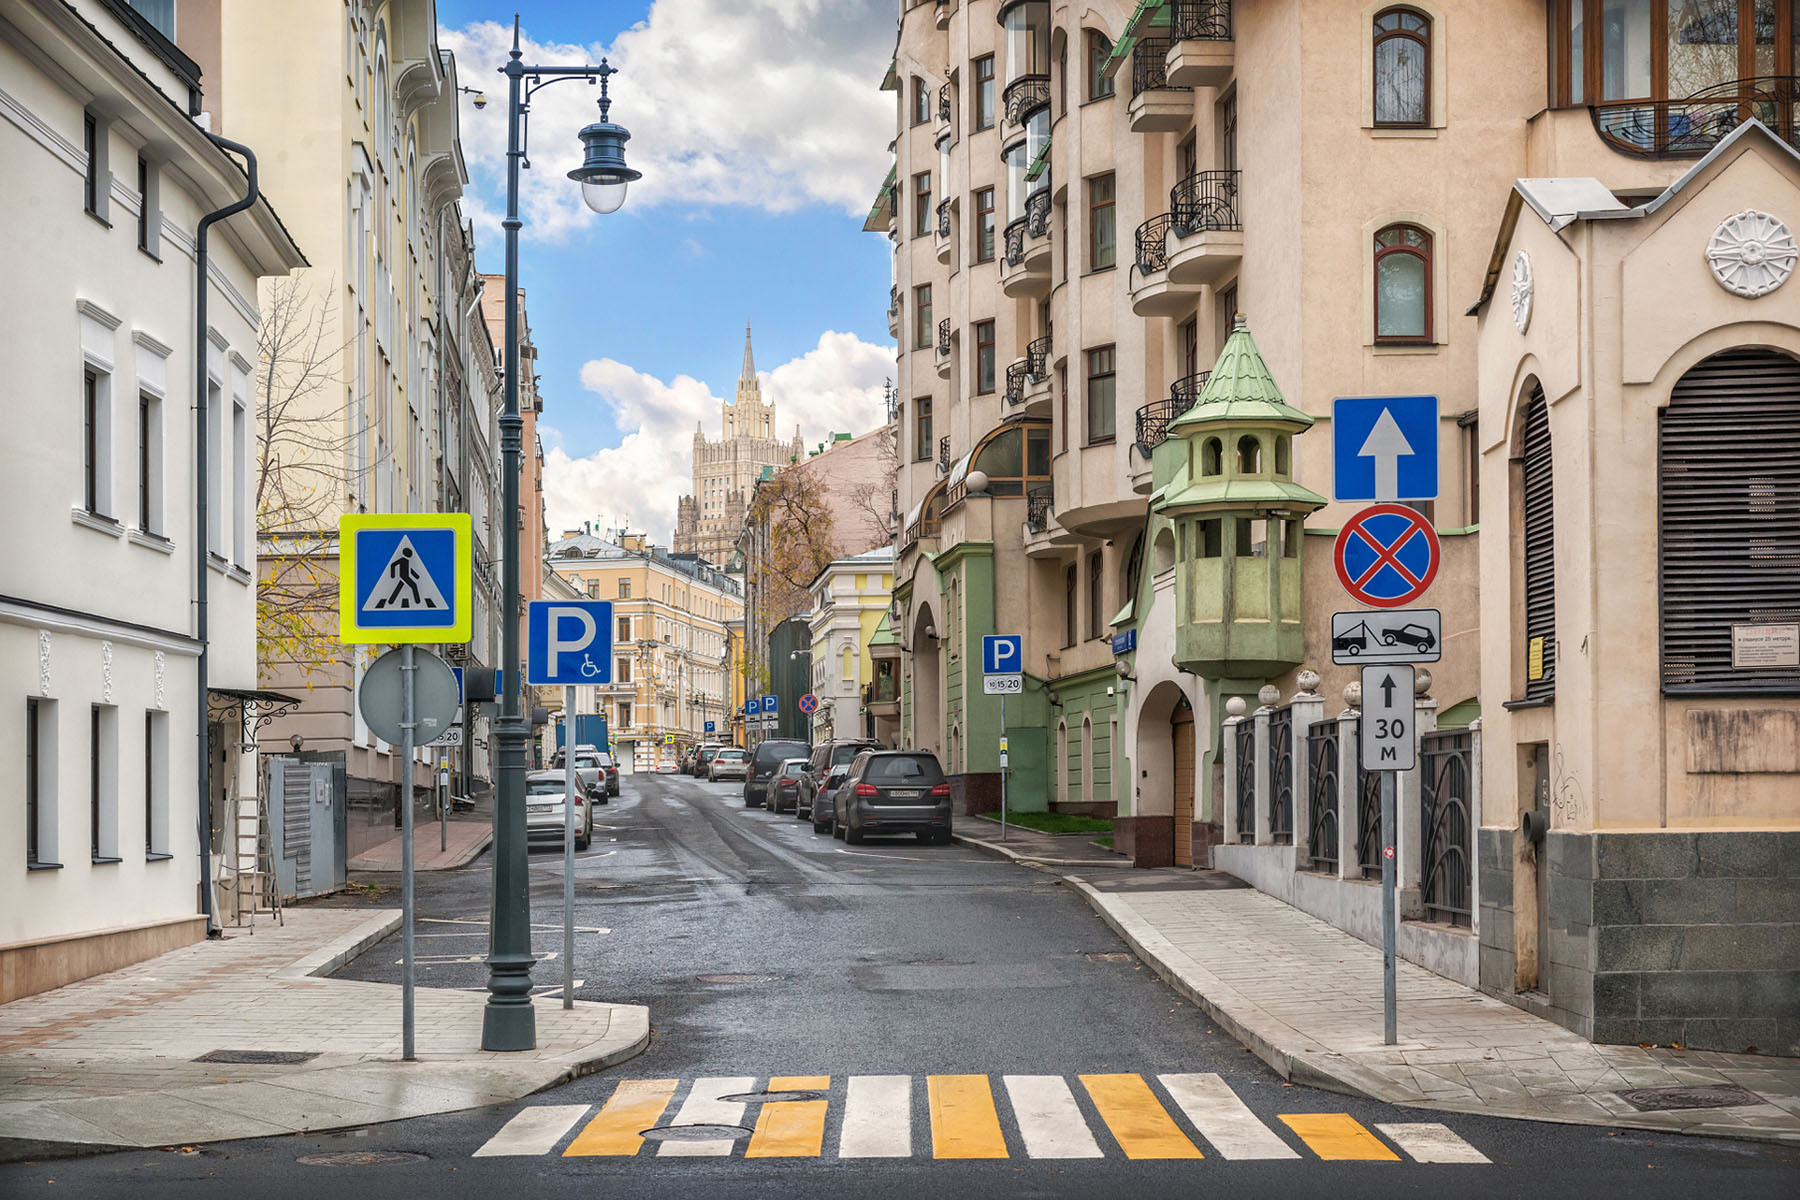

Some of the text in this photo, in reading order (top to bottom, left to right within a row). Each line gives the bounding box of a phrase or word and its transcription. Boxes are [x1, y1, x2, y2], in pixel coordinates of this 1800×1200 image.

[547, 607, 596, 677] P
[994, 640, 1014, 669] P
[1007, 680, 1019, 688] 20
[749, 702, 757, 713] P
[766, 698, 775, 710] P
[706, 723, 713, 731] P
[1375, 719, 1404, 739] 30
[447, 732, 458, 741] 20
